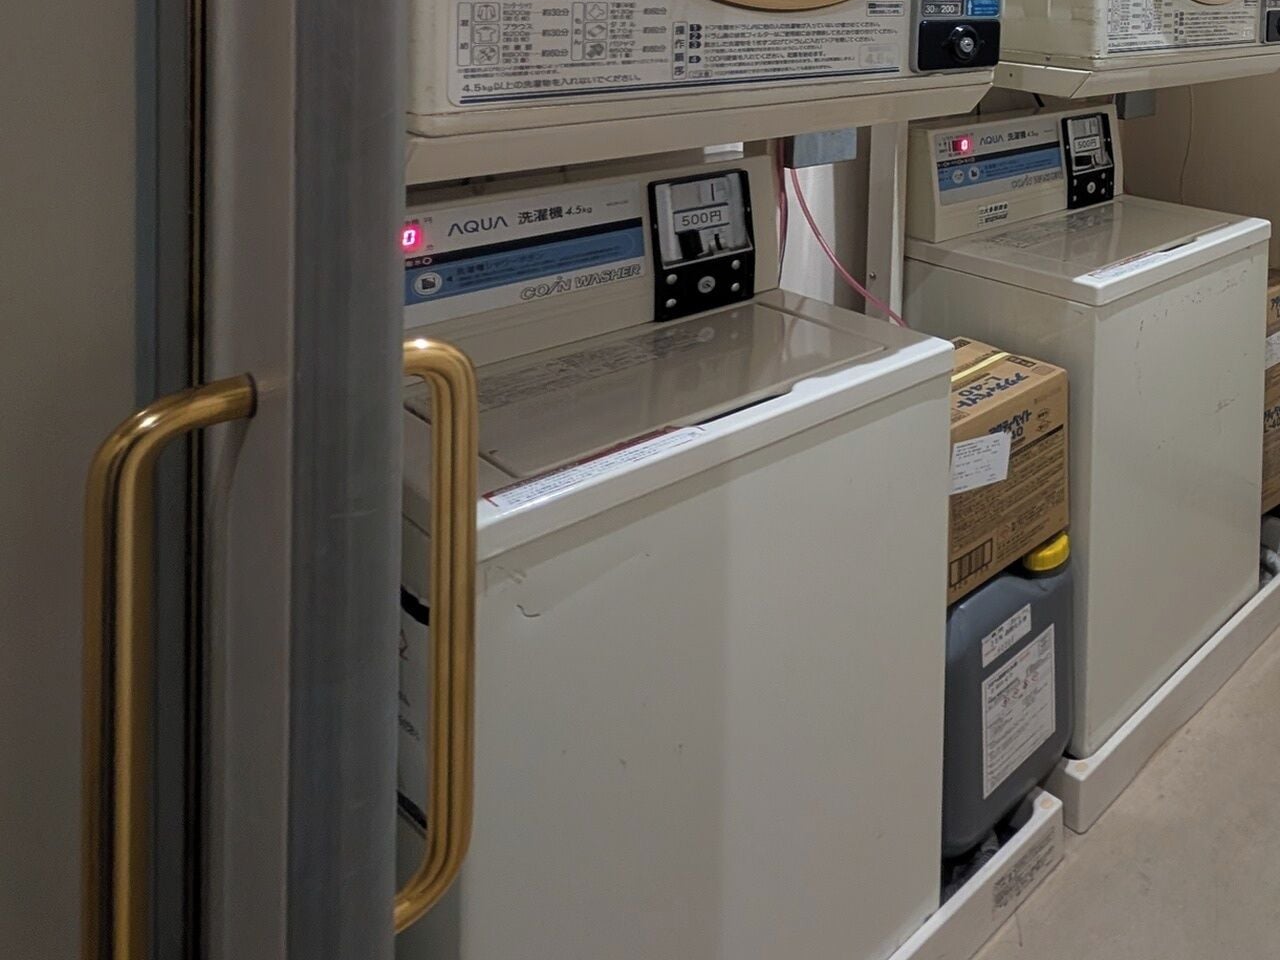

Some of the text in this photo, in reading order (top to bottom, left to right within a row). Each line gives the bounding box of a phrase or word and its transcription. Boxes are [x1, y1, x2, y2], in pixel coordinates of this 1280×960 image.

[979, 134, 1004, 146] AQUA
[448, 204, 593, 237] AQUA 洗濯機 4.5kg
[681, 210, 722, 227] 500円
[574, 263, 642, 288] WASHER
